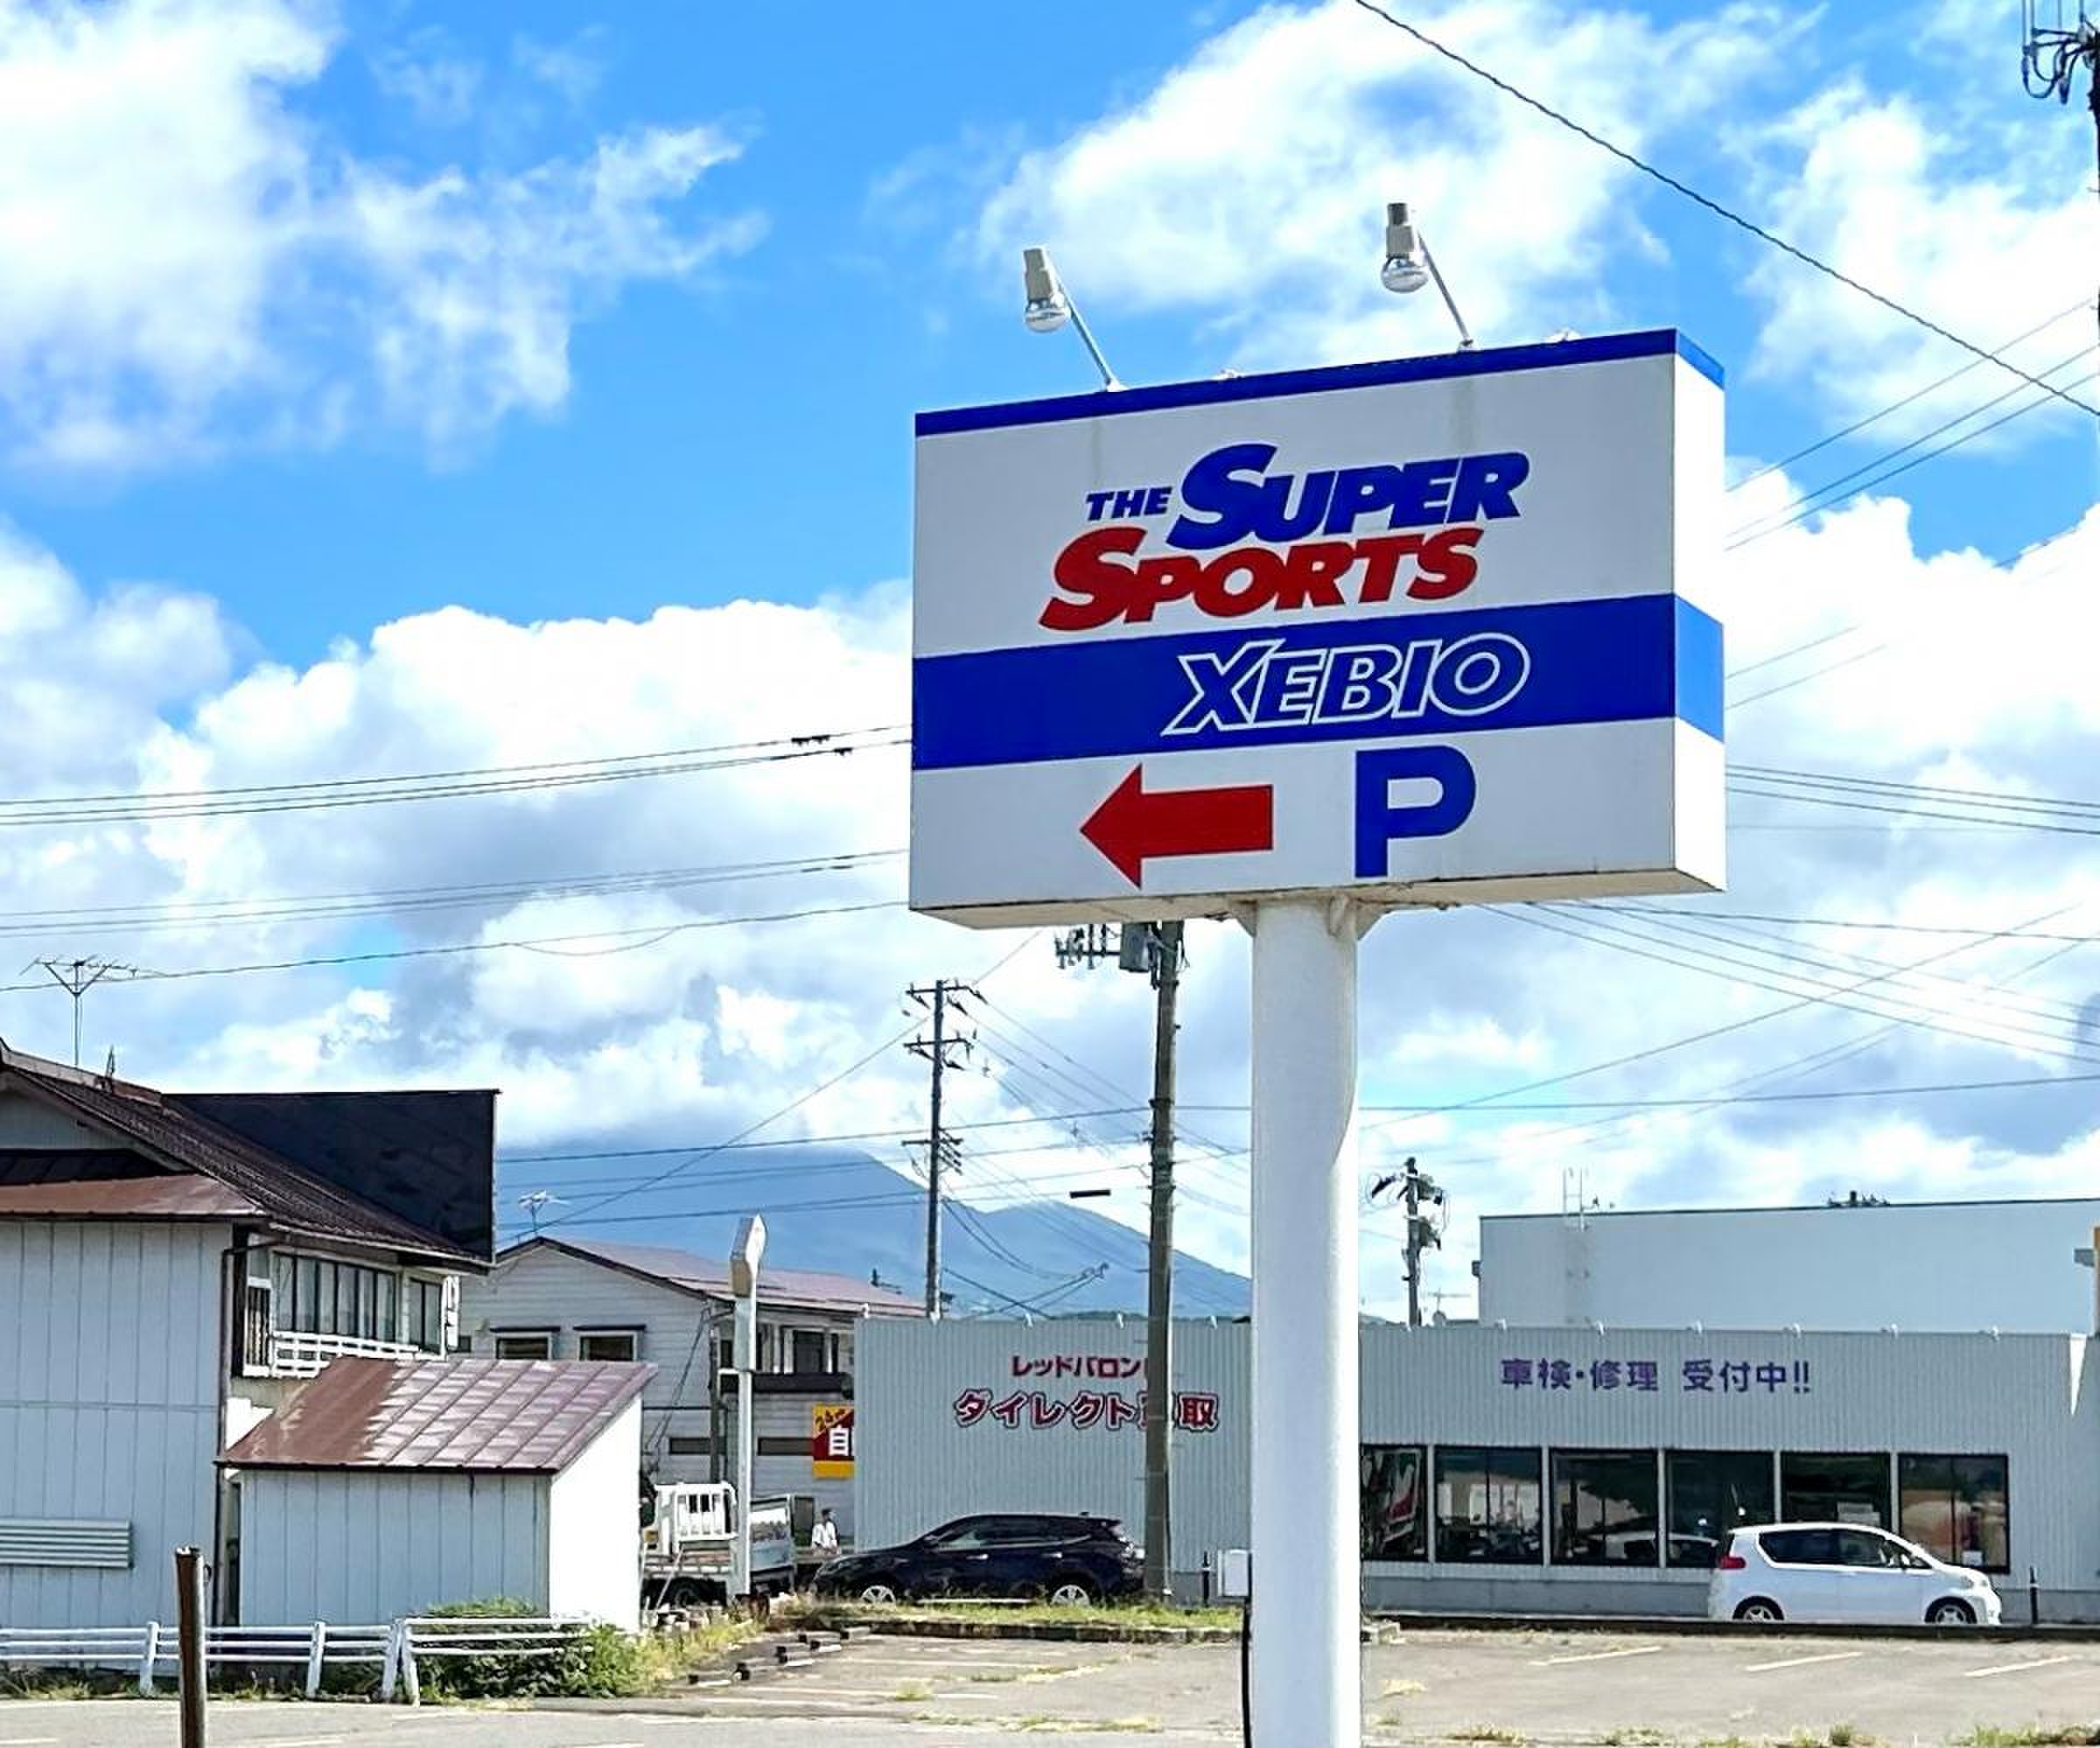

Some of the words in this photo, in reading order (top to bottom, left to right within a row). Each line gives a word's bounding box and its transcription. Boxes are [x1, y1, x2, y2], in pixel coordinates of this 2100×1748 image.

[1086, 486, 1172, 521] THE
[1166, 444, 1530, 549] SUPER
[1039, 527, 1485, 631] SPORTS
[1160, 632, 1531, 737] XEBIO
[1355, 745, 1476, 877] P
[954, 1388, 1219, 1432] ダイレクト取
[1011, 1355, 1148, 1379] レッドバロン
